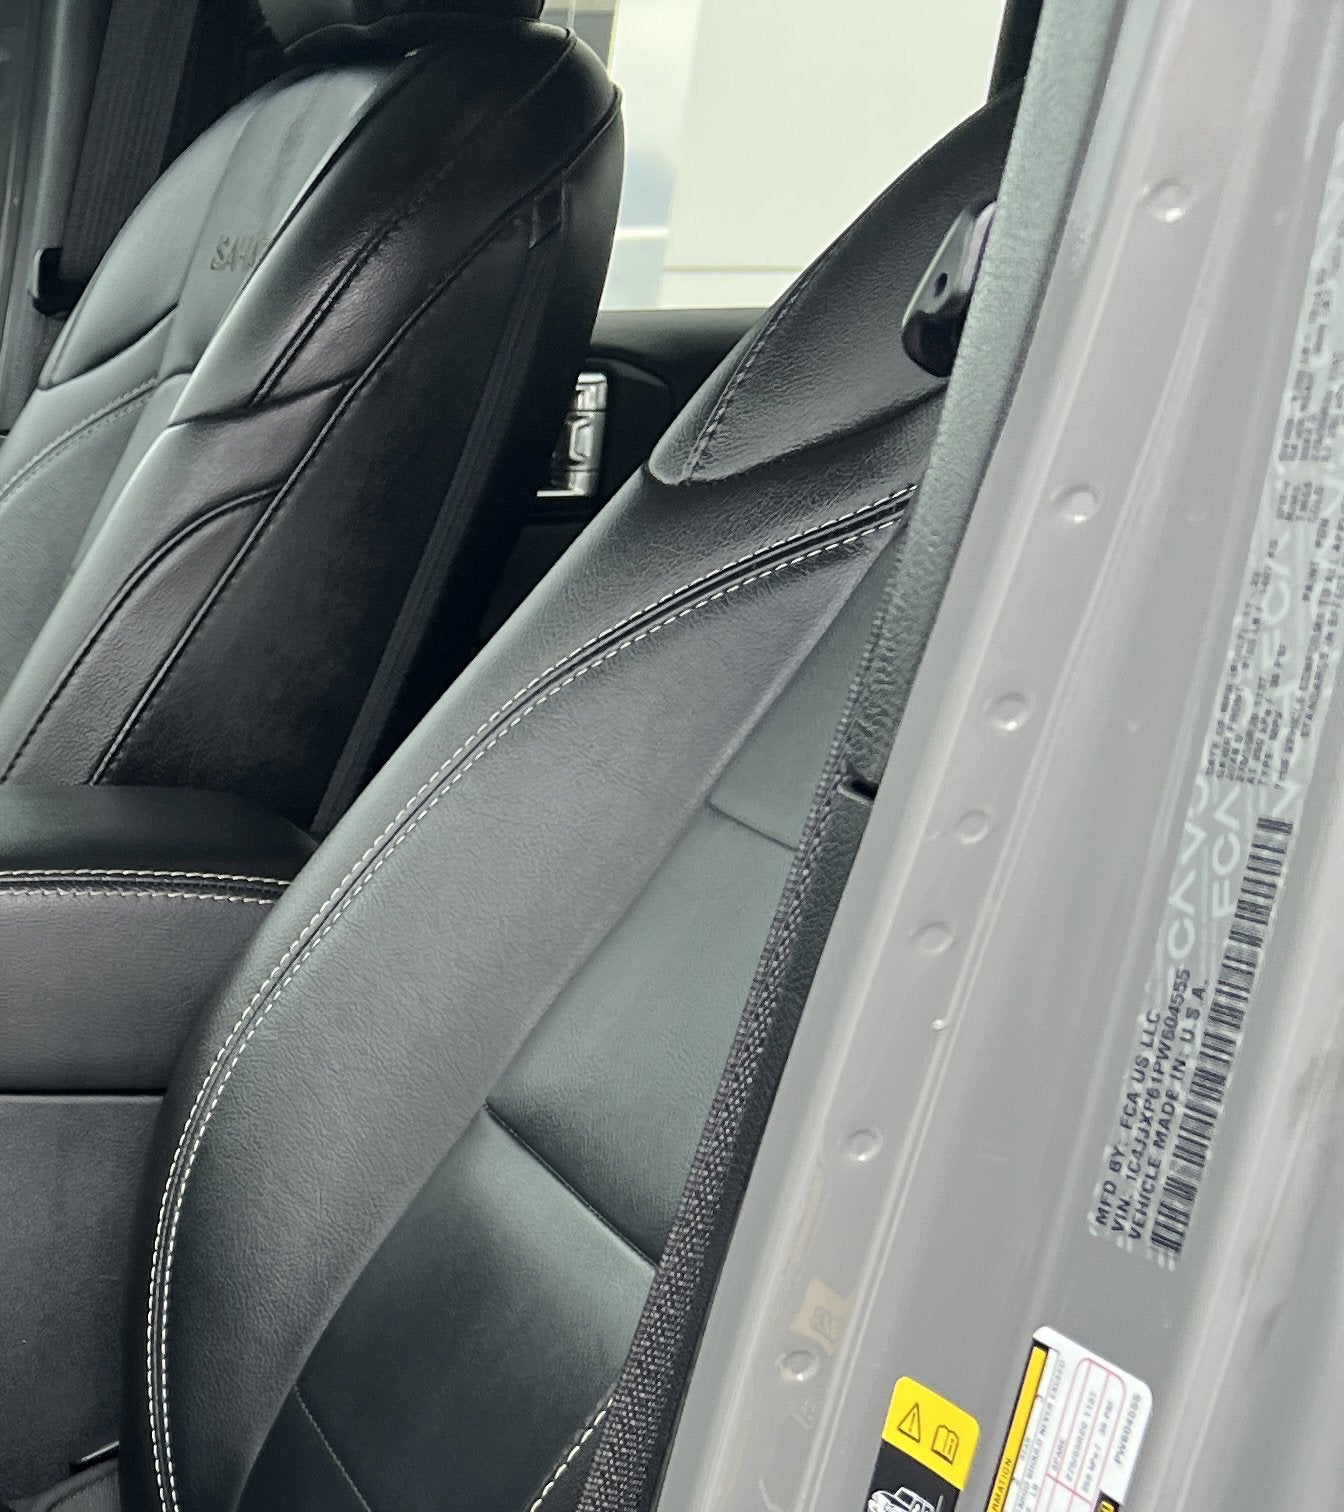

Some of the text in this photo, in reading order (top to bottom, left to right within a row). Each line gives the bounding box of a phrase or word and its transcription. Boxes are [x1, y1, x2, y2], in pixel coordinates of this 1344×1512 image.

[1139, 1008, 1161, 1049] LLC
[1129, 1052, 1150, 1085] US
[1118, 1088, 1140, 1130] FCA
[1127, 1153, 1161, 1243] VEHICLE
[1152, 1087, 1179, 1150] MADE
[1093, 1177, 1117, 1226] MFD
